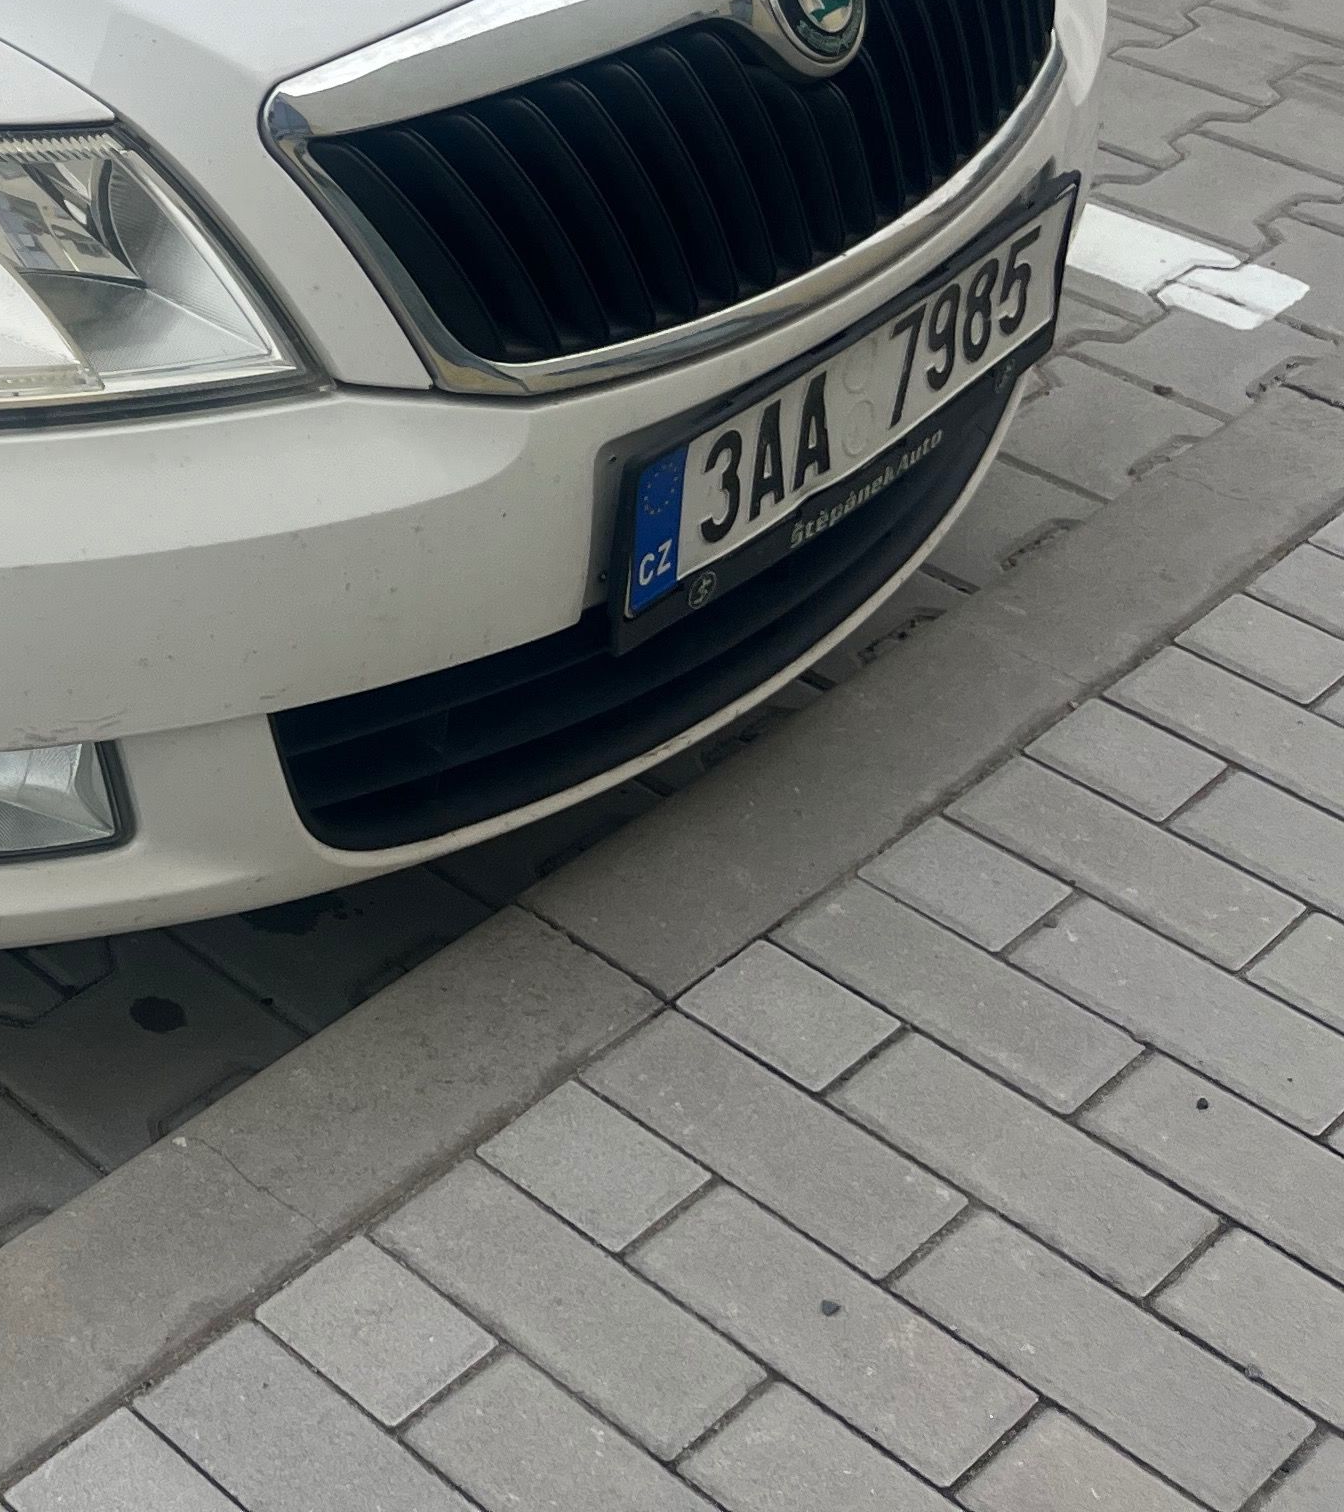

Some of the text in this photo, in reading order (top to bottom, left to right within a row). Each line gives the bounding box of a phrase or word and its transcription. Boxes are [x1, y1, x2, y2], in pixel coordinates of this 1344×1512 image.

[701, 225, 1042, 543] 3AA 7985
[639, 539, 672, 586] CZ
